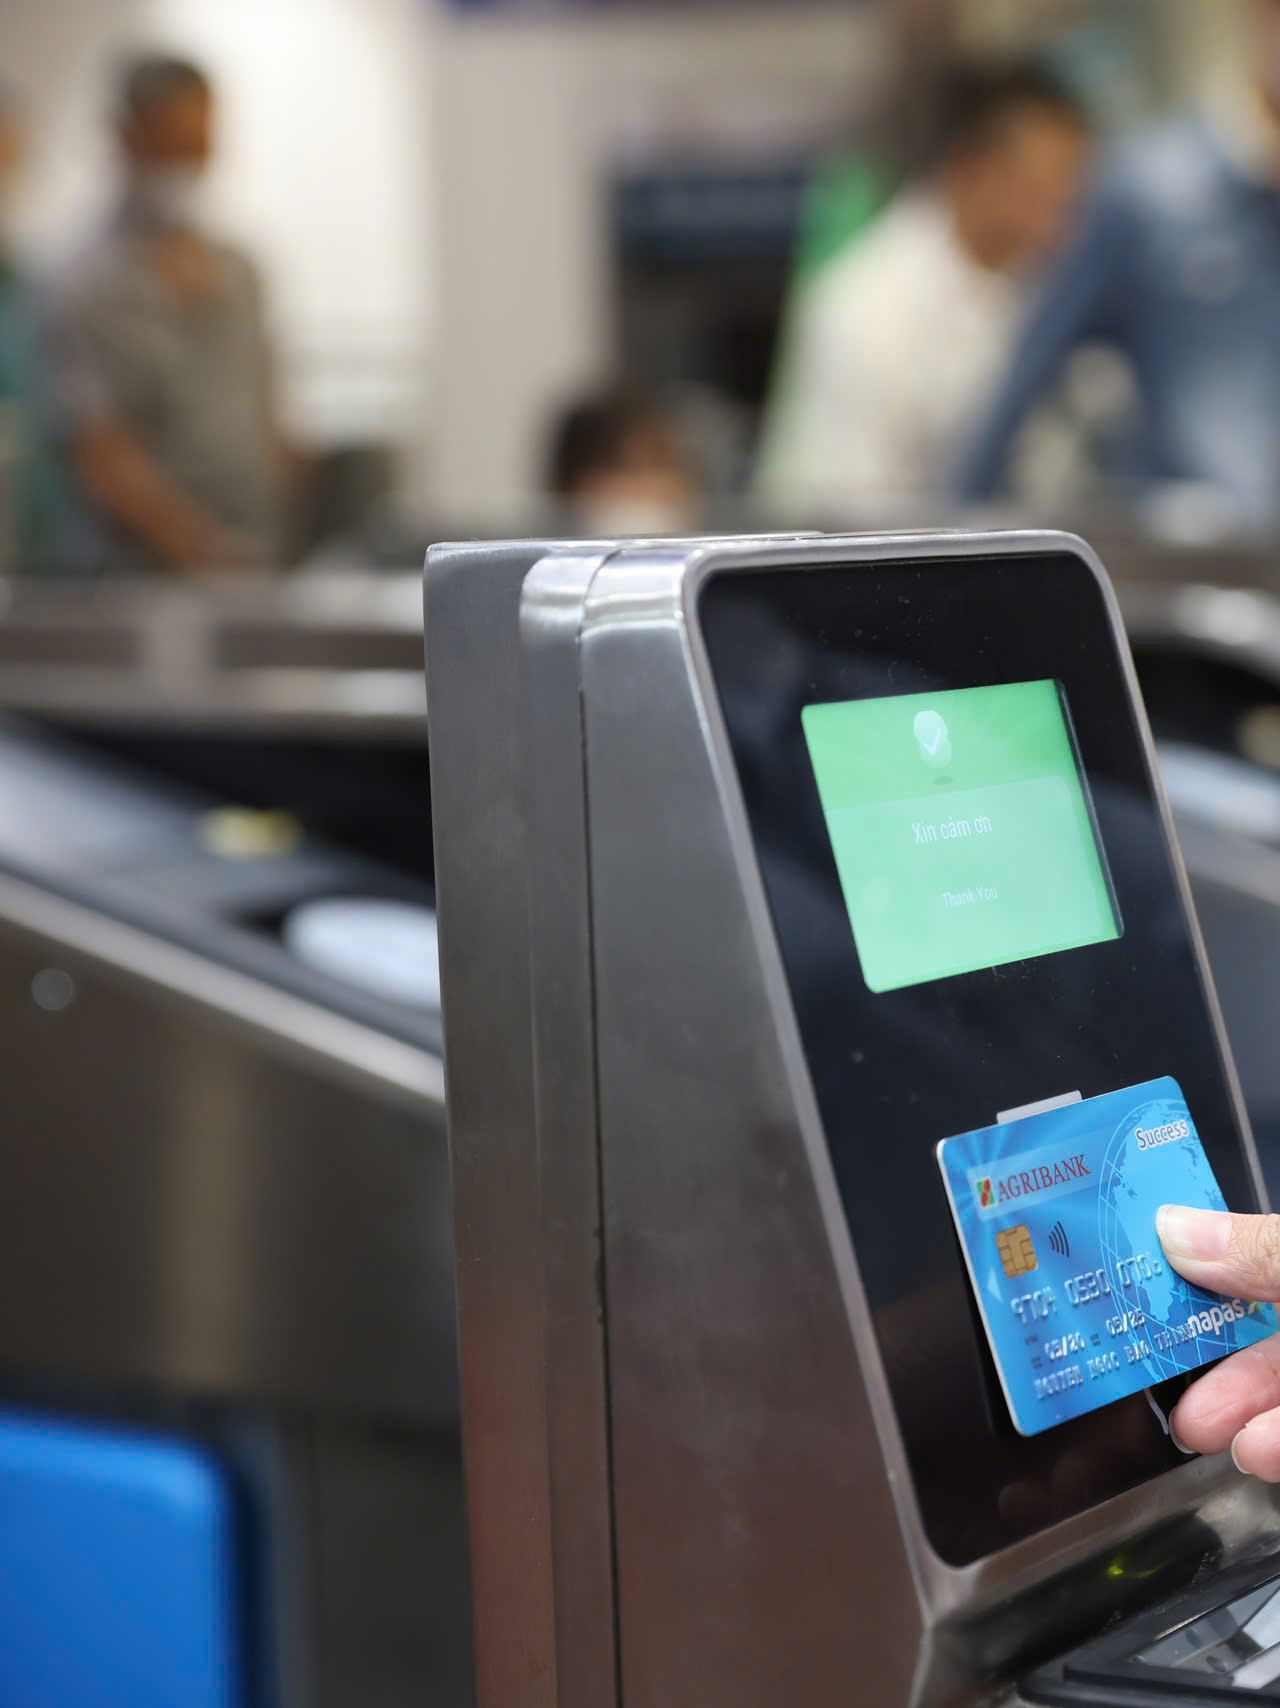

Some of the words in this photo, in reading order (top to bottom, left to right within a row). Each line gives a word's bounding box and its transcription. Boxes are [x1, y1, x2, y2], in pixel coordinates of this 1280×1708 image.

[912, 820, 938, 845] Xin
[1136, 1120, 1189, 1149] Success
[997, 1154, 1091, 1203] AGRIBANK
[1187, 1299, 1245, 1337] napas
